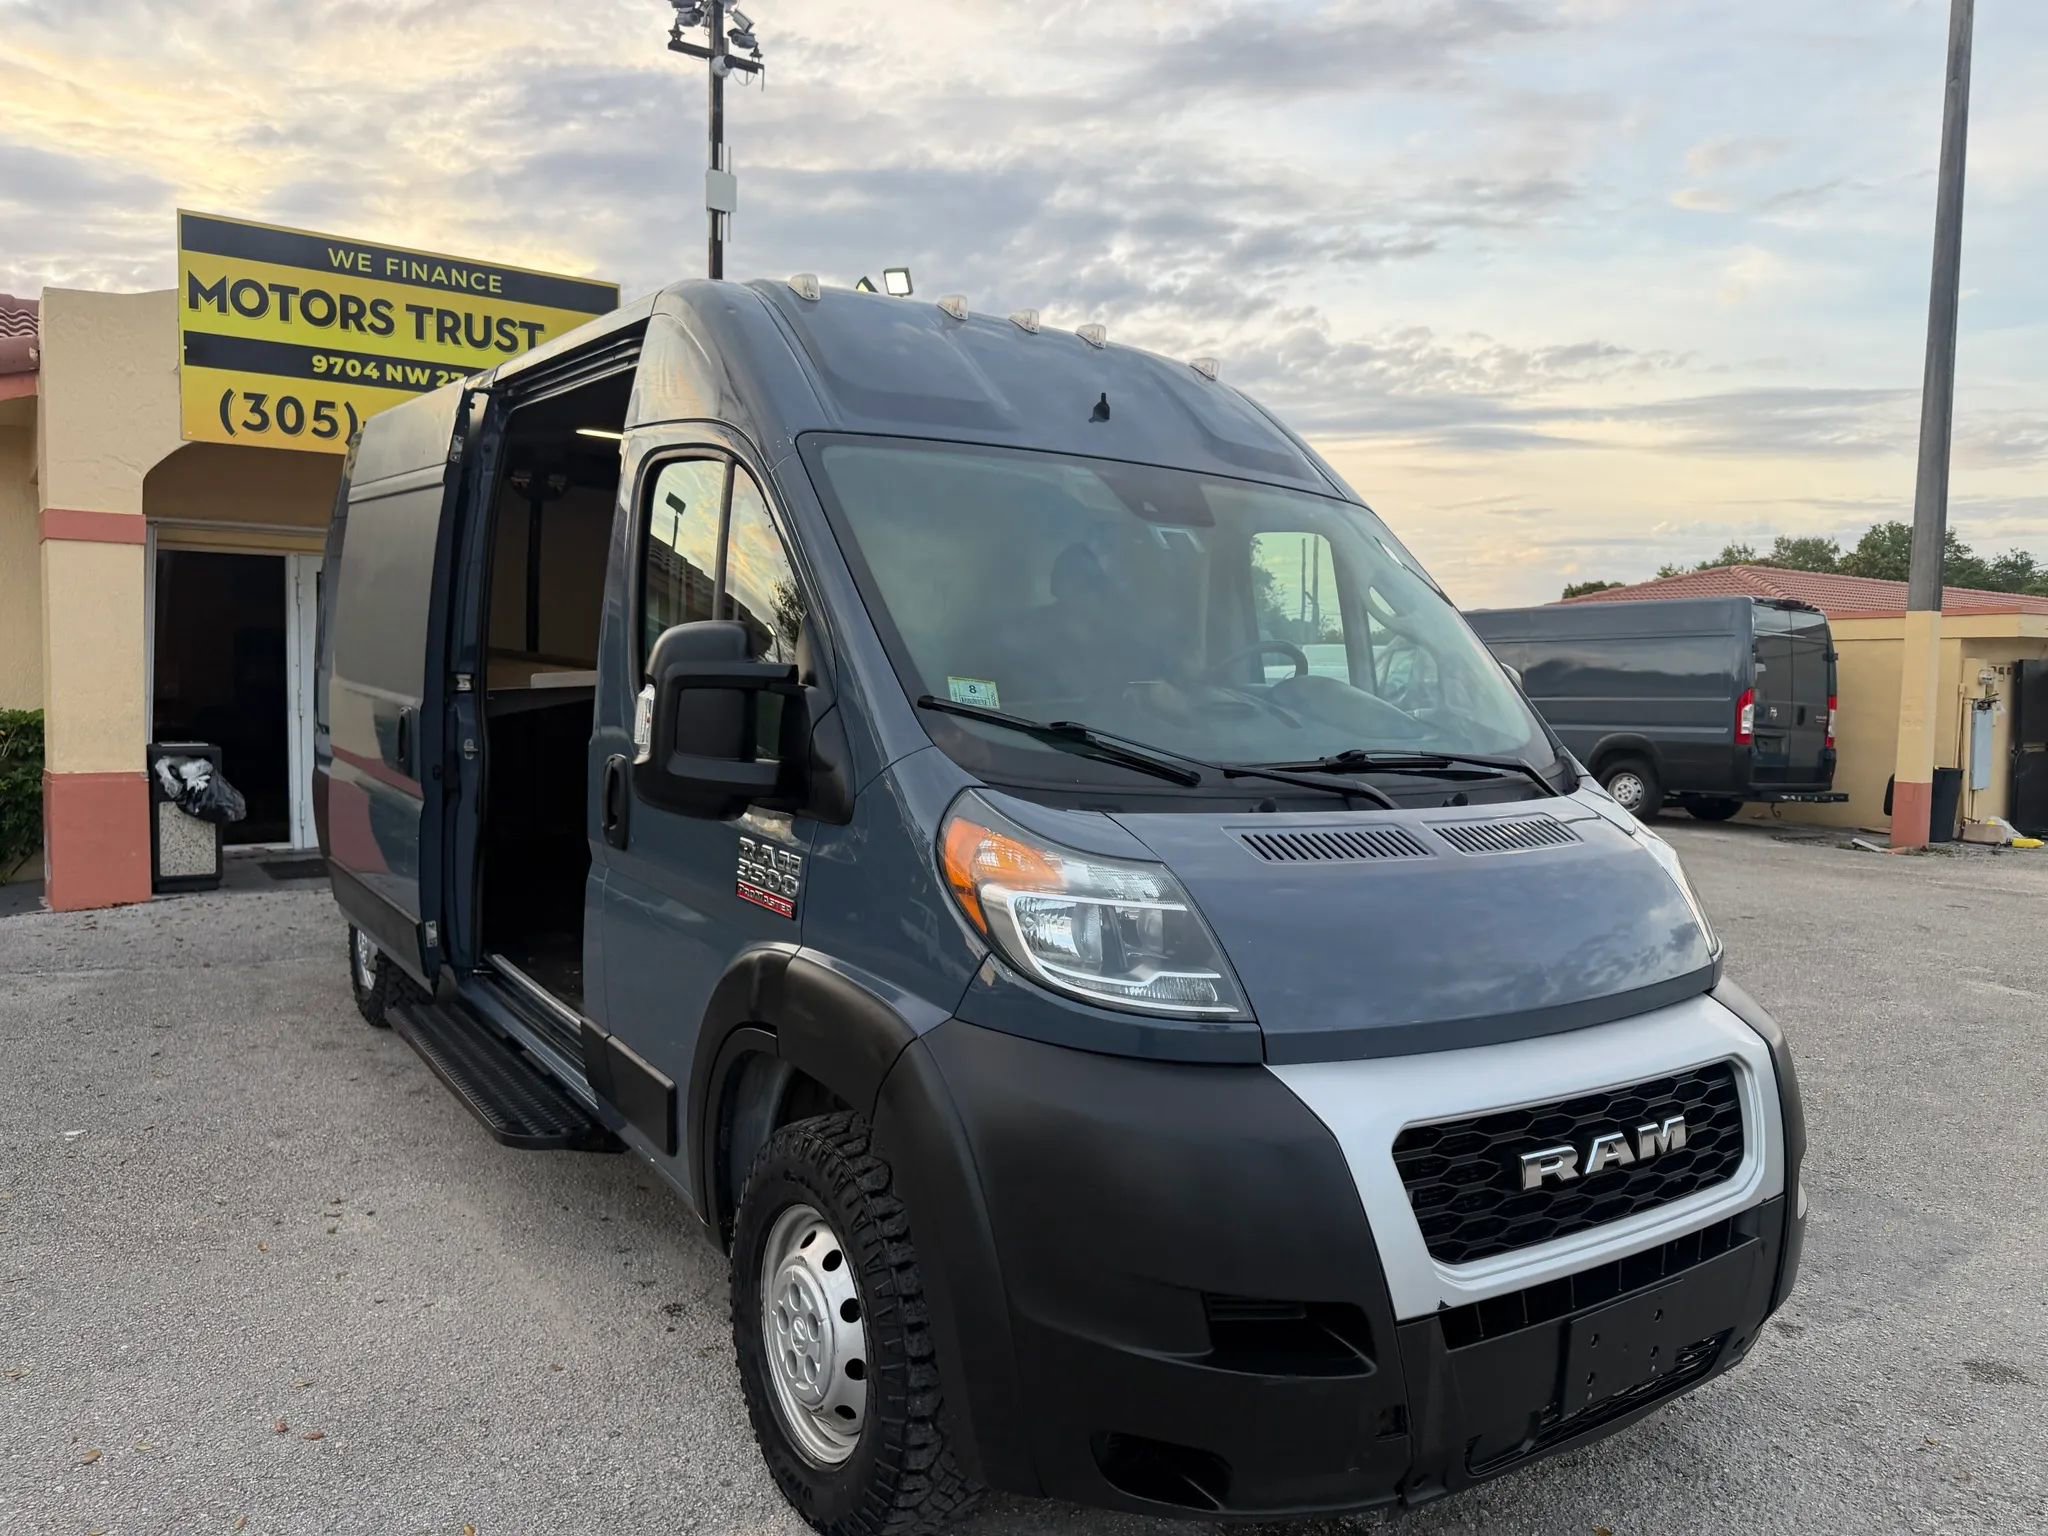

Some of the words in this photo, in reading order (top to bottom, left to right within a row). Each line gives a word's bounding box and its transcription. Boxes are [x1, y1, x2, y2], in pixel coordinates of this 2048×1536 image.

[327, 247, 372, 273] WE
[386, 257, 503, 293] FINANCE
[187, 269, 397, 337] MOTORS
[405, 303, 545, 354] TRUST
[311, 354, 381, 380] 9704
[386, 363, 431, 386] NW
[219, 388, 366, 447] (305)
[968, 684, 977, 694] 8
[737, 857, 800, 899] 3500
[739, 836, 803, 877] RAM
[1521, 1115, 1687, 1191] RAM
